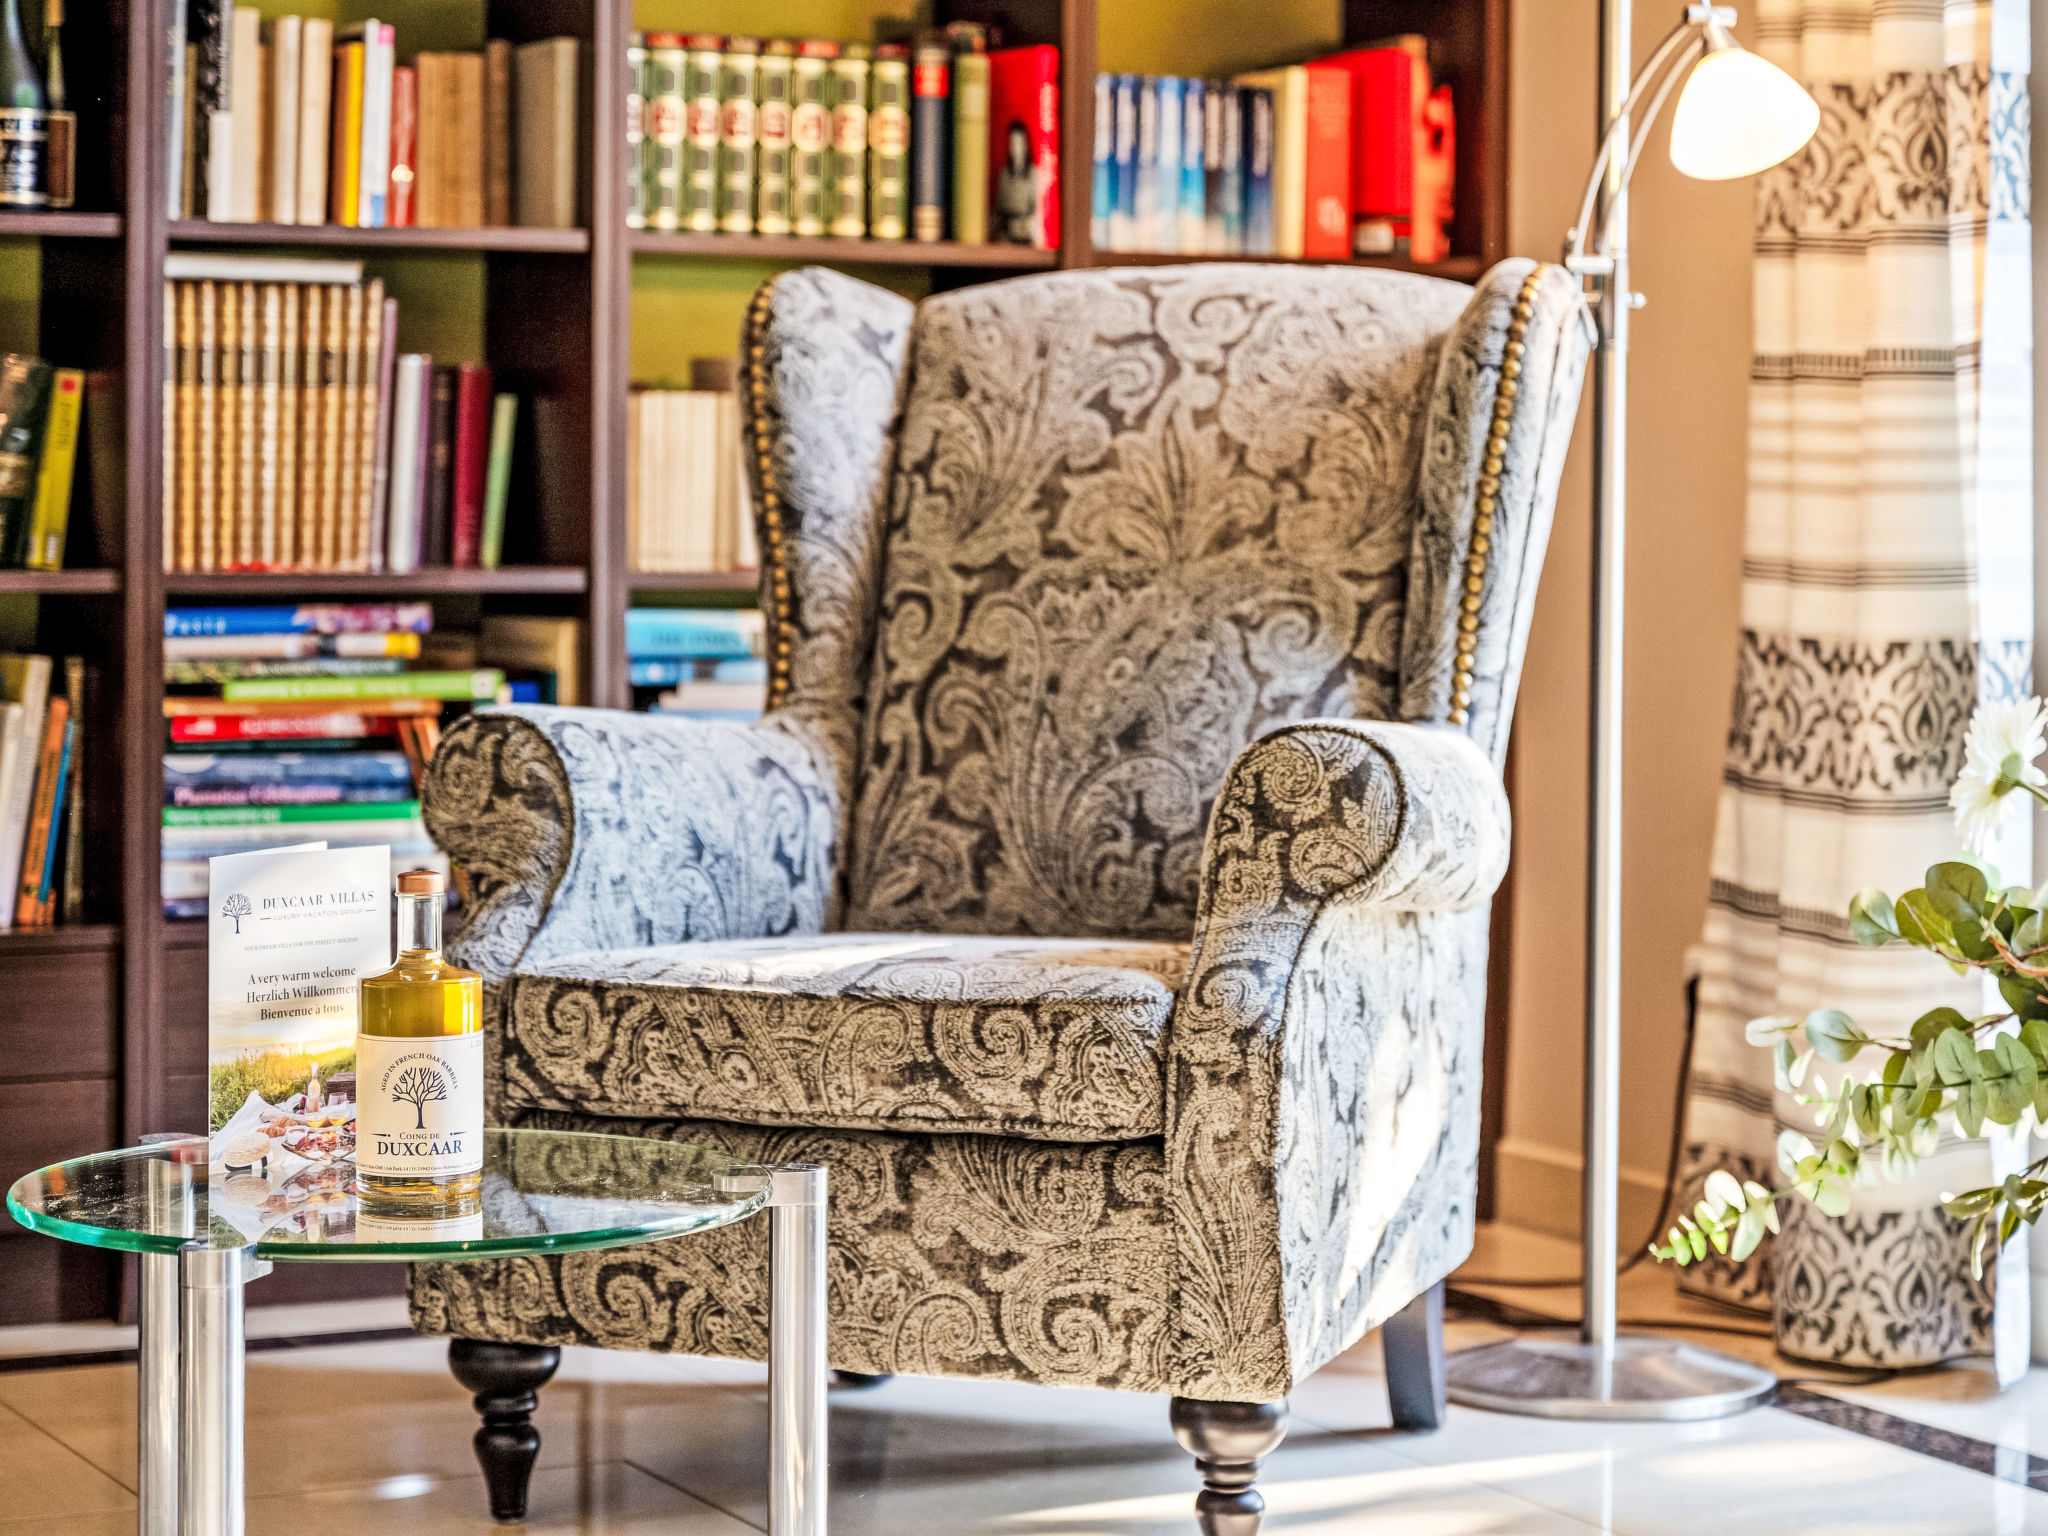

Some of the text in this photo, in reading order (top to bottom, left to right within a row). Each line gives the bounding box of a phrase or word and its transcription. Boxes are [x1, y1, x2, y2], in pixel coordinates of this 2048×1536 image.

[263, 890, 375, 910] DUXCAAR VILLAS
[273, 908, 363, 921] LUXURY VACATION GROUP
[248, 966, 356, 986] A very warm welcome
[247, 985, 357, 1003] Herzlich Willkommen
[260, 1003, 344, 1020] Bienvenue à tous
[381, 1052, 459, 1092] AGED IN FRENCH OAK BARRELS
[377, 1139, 463, 1156] DUXCAAR
